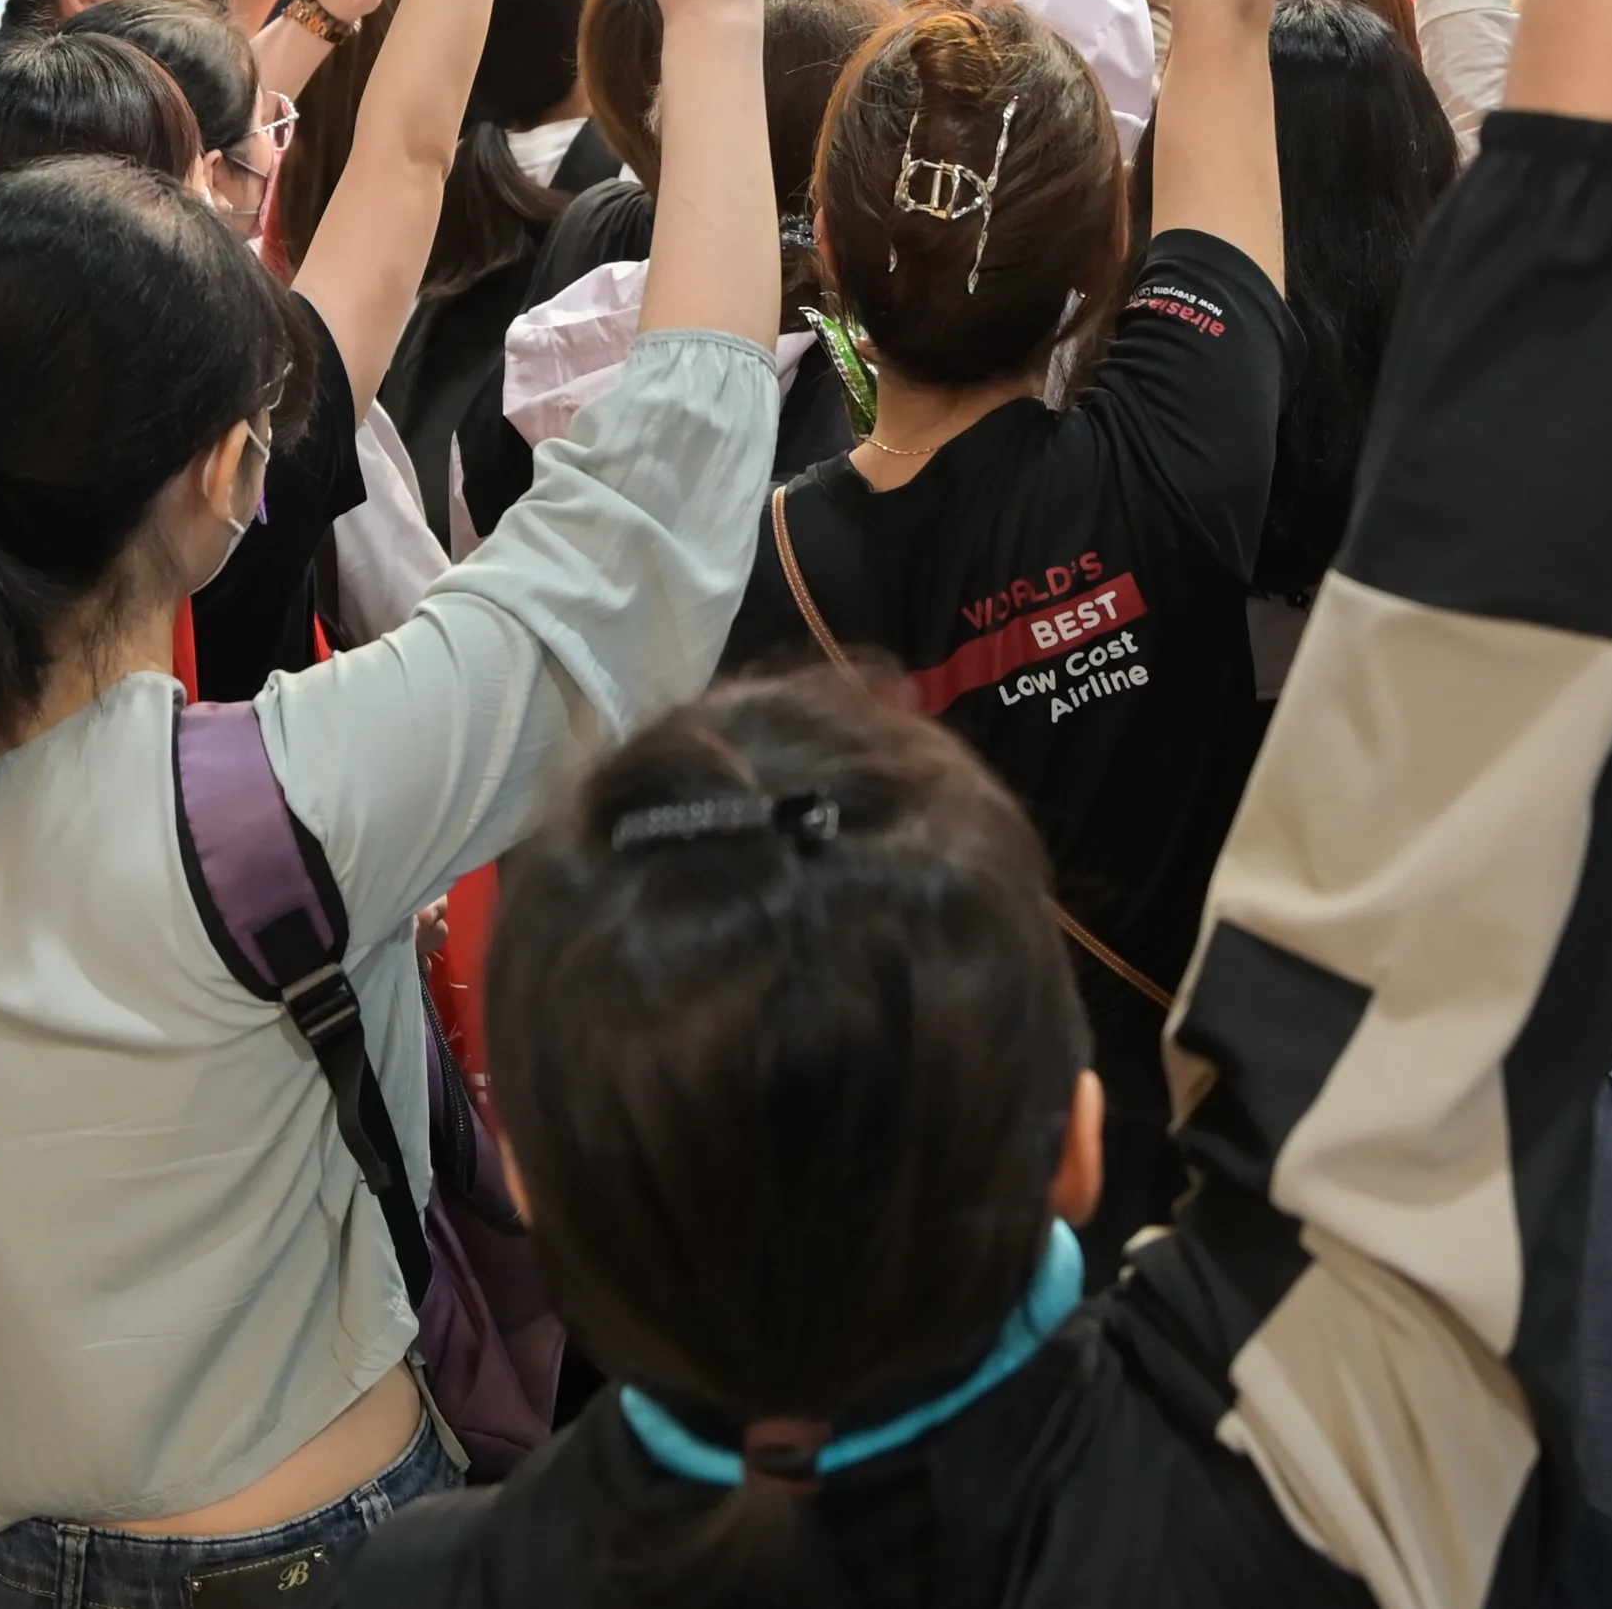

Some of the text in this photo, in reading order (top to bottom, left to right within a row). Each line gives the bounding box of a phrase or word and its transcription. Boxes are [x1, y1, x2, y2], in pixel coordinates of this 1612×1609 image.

[1152, 286, 1197, 304] Everyone
[1198, 298, 1223, 317] Now
[961, 551, 1104, 629] WORLD'S
[1030, 590, 1117, 649] BEST
[1065, 631, 1139, 676] Cost
[1050, 664, 1150, 723] Airline
